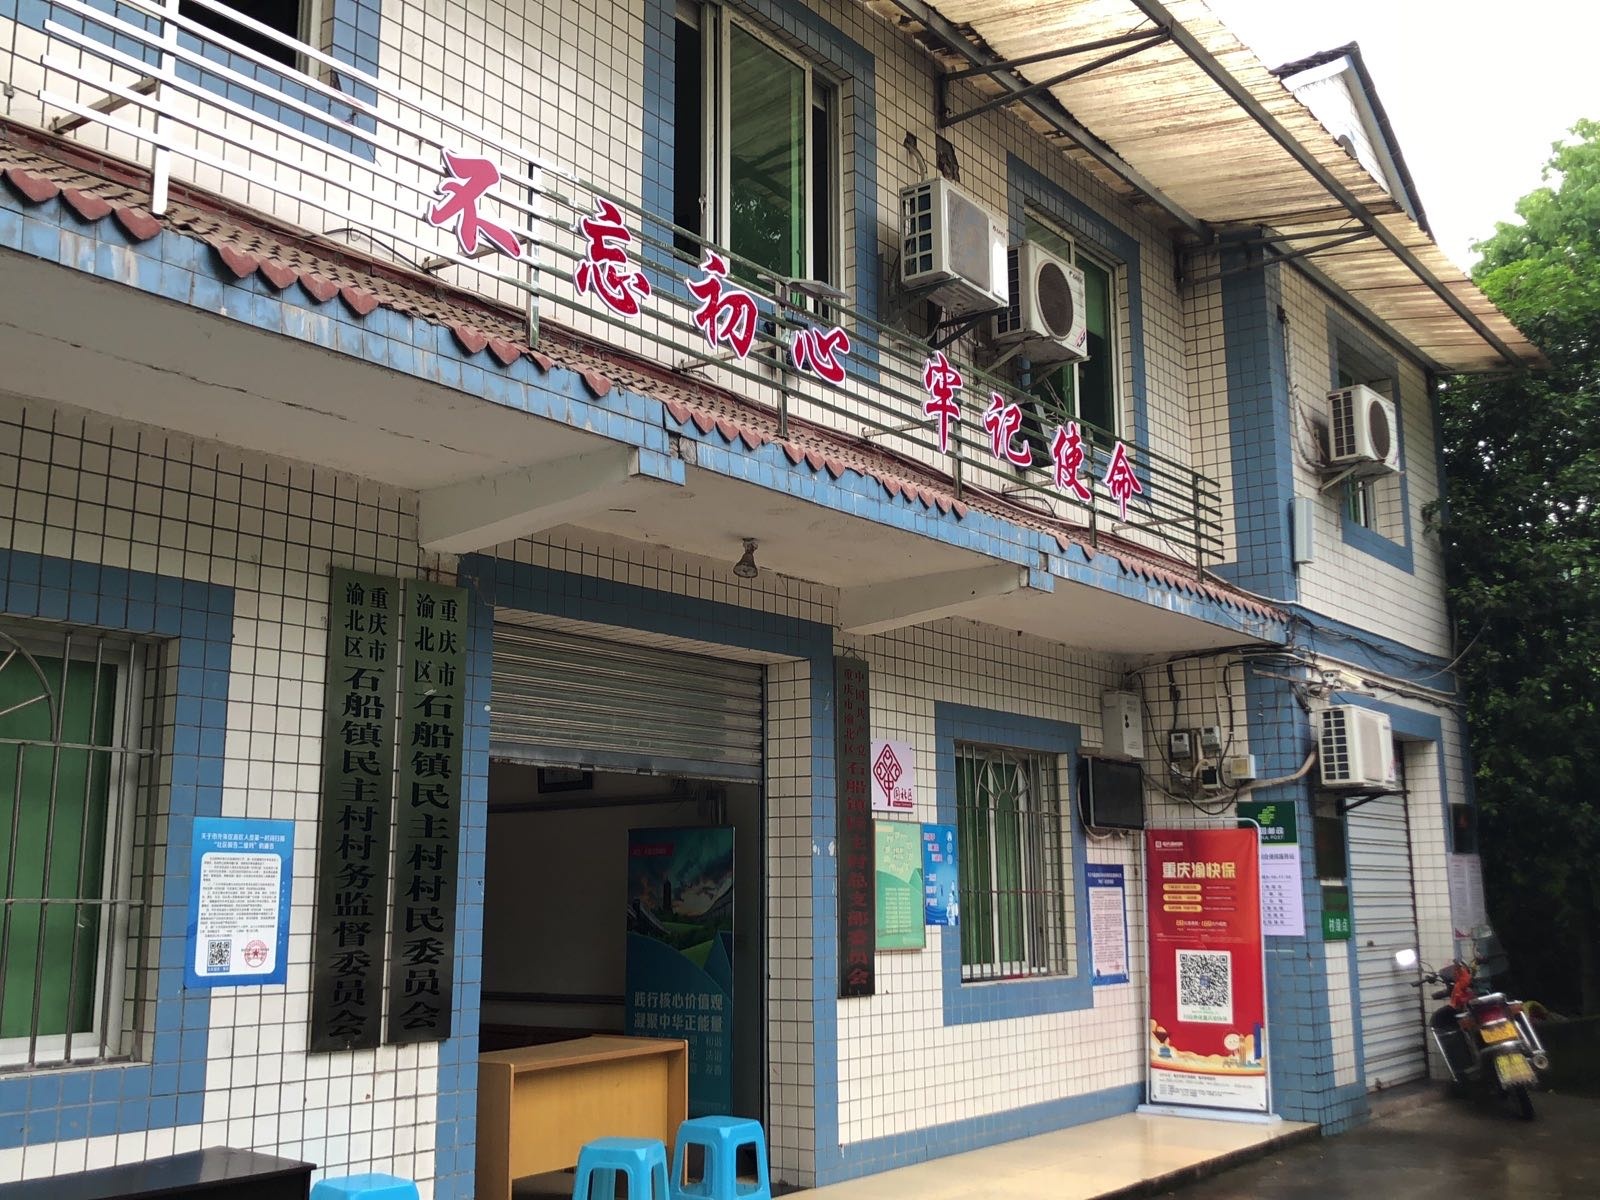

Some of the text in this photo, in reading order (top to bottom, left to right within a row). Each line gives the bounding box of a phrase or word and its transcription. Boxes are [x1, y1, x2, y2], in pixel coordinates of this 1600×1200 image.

[427, 146, 1143, 522] 不忘初心 牢记使命
[344, 582, 366, 659] 渝北区
[367, 587, 389, 663] 重庆市
[414, 592, 436, 684] 渝北区
[437, 599, 459, 687] 重庆市
[327, 665, 386, 1037] 石船镇民主村村务监督委员会
[400, 692, 455, 1030] 石船镇民主村村民委员会
[1162, 861, 1236, 879] 重庆渝快保
[633, 1012, 723, 1032] 凝聚中华正能量
[634, 991, 723, 1011] 践行核心价值观
